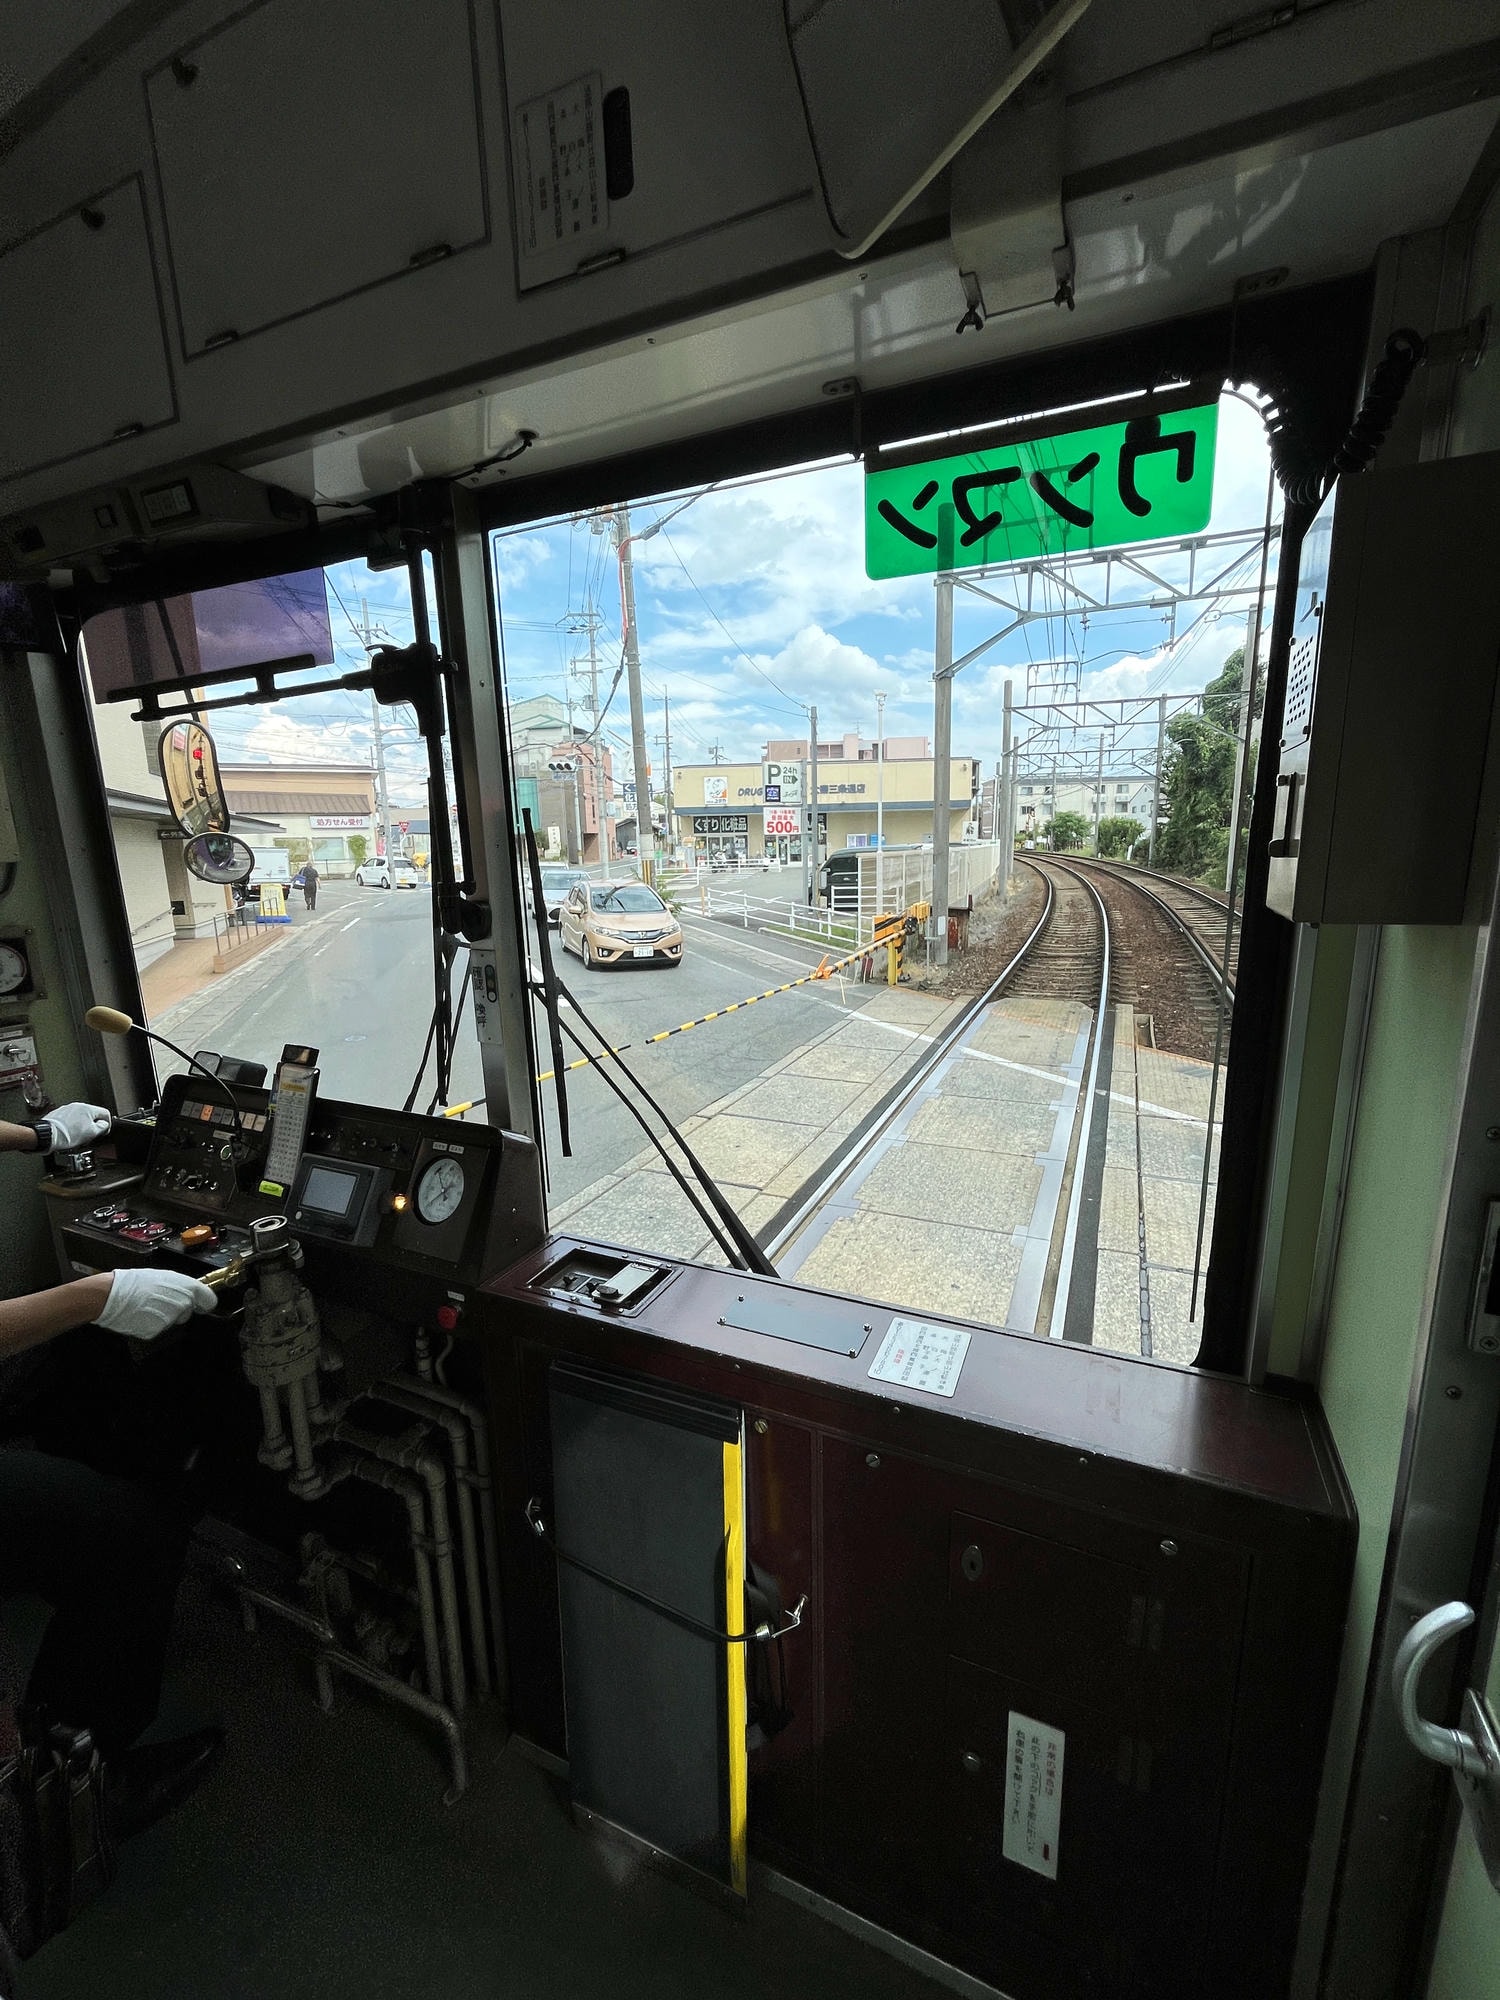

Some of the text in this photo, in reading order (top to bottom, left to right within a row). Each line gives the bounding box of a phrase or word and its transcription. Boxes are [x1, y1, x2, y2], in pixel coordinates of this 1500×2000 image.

[768, 764, 798, 784] P 24h
[737, 787, 763, 797] DRUG
[316, 818, 363, 826] 処方せん受付
[694, 817, 747, 832] くすり 化粧品
[767, 821, 799, 833] 500円
